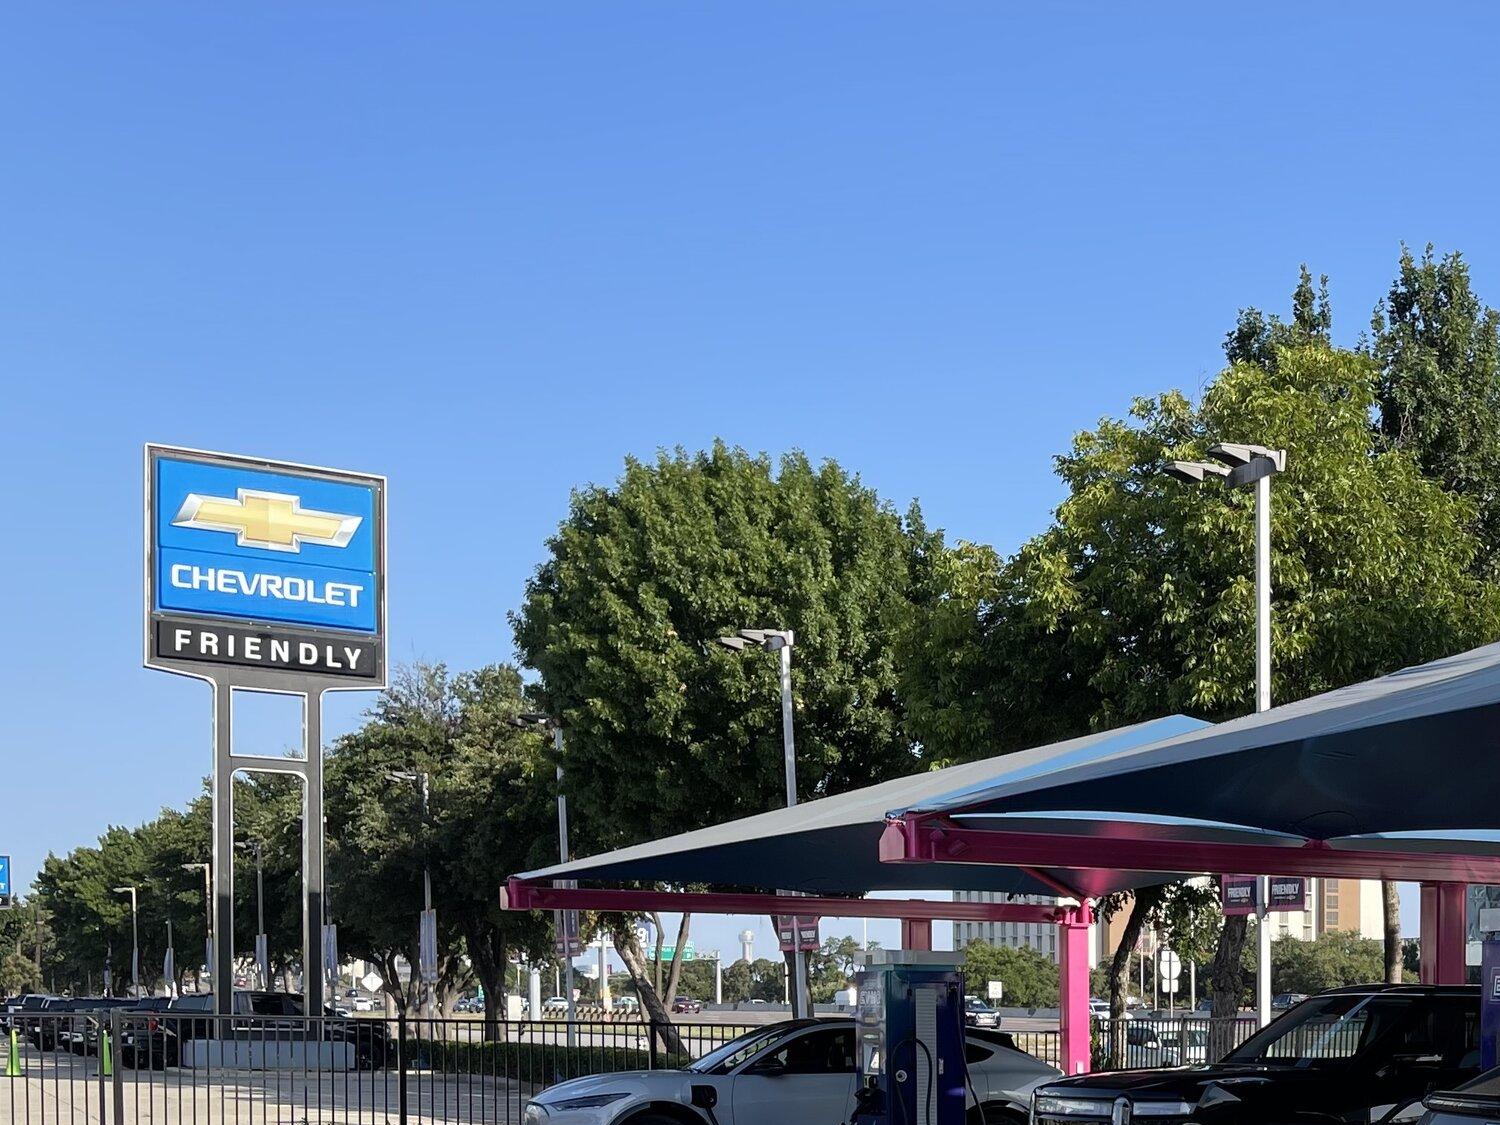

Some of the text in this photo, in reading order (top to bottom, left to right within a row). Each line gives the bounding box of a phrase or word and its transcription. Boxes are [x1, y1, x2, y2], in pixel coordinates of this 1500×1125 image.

[171, 563, 364, 607] CHEVROLET
[174, 629, 362, 670] FRIENDLY
[1271, 883, 1300, 895] FRIENDLY
